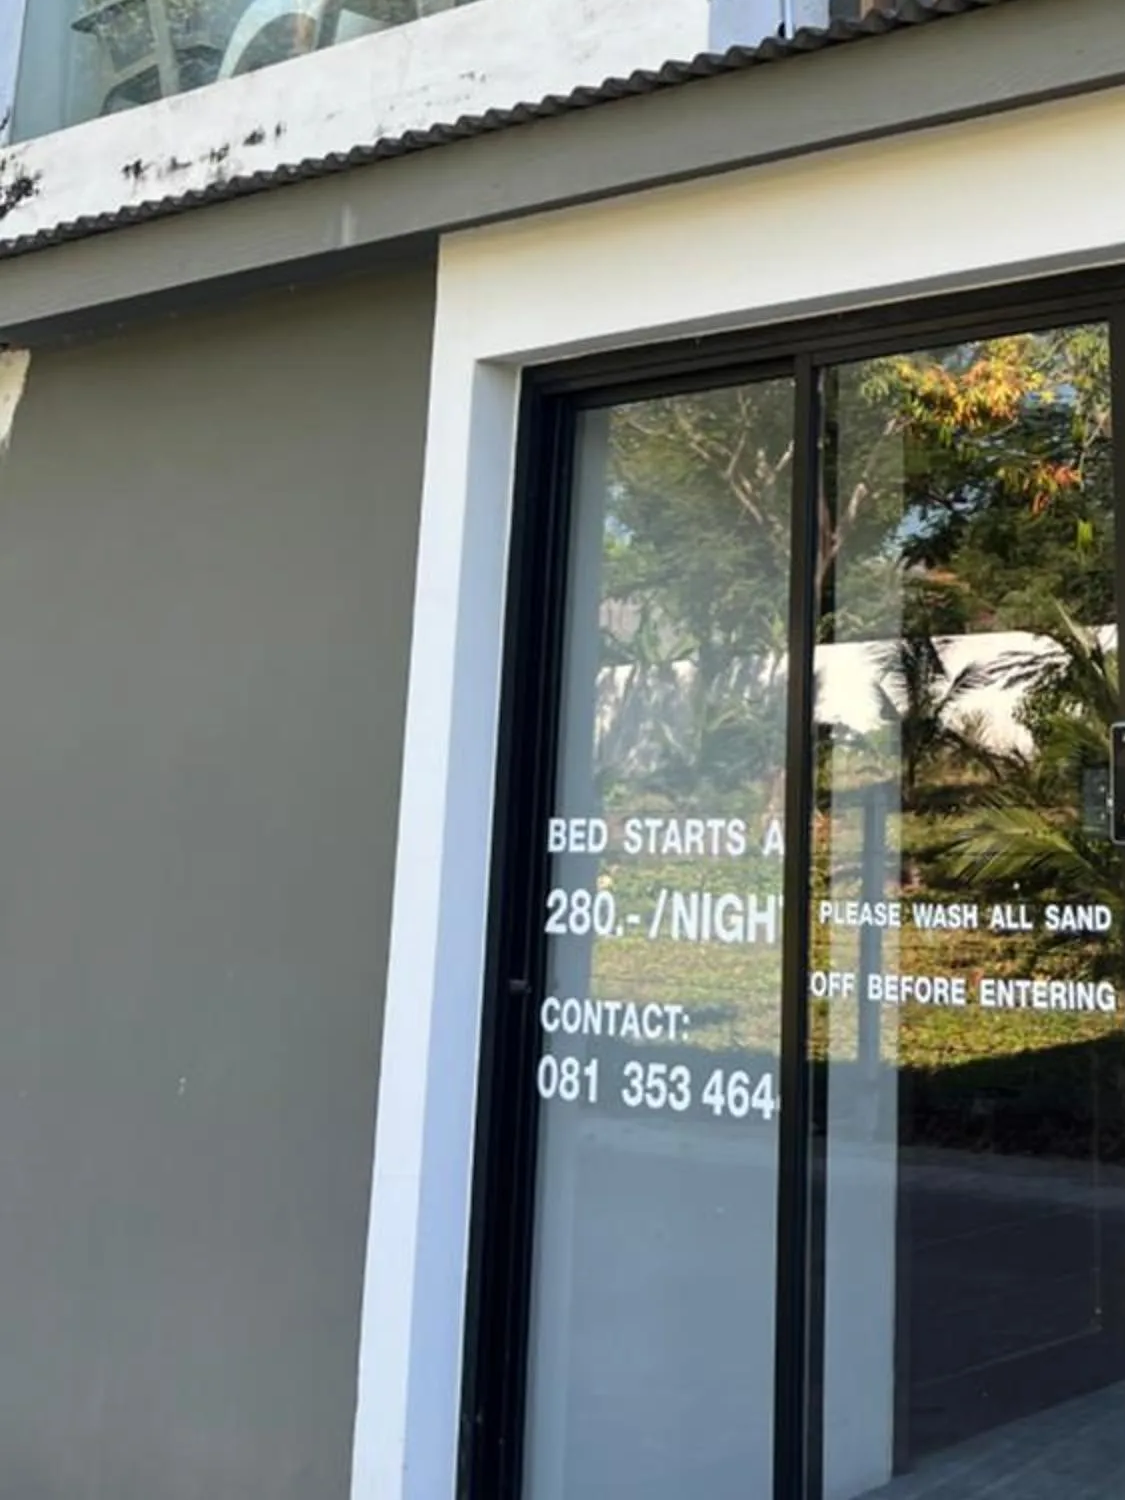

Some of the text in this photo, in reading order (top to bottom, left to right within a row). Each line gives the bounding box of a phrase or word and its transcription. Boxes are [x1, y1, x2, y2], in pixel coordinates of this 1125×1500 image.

[547, 817, 785, 857] BED STARTS A
[818, 900, 1113, 932] PLEASE WASH ALL SAND
[809, 970, 1117, 1012] OFF BEFORE ENTERING
[540, 995, 690, 1041] CONTACT:
[536, 1053, 781, 1121] 081 353 464
